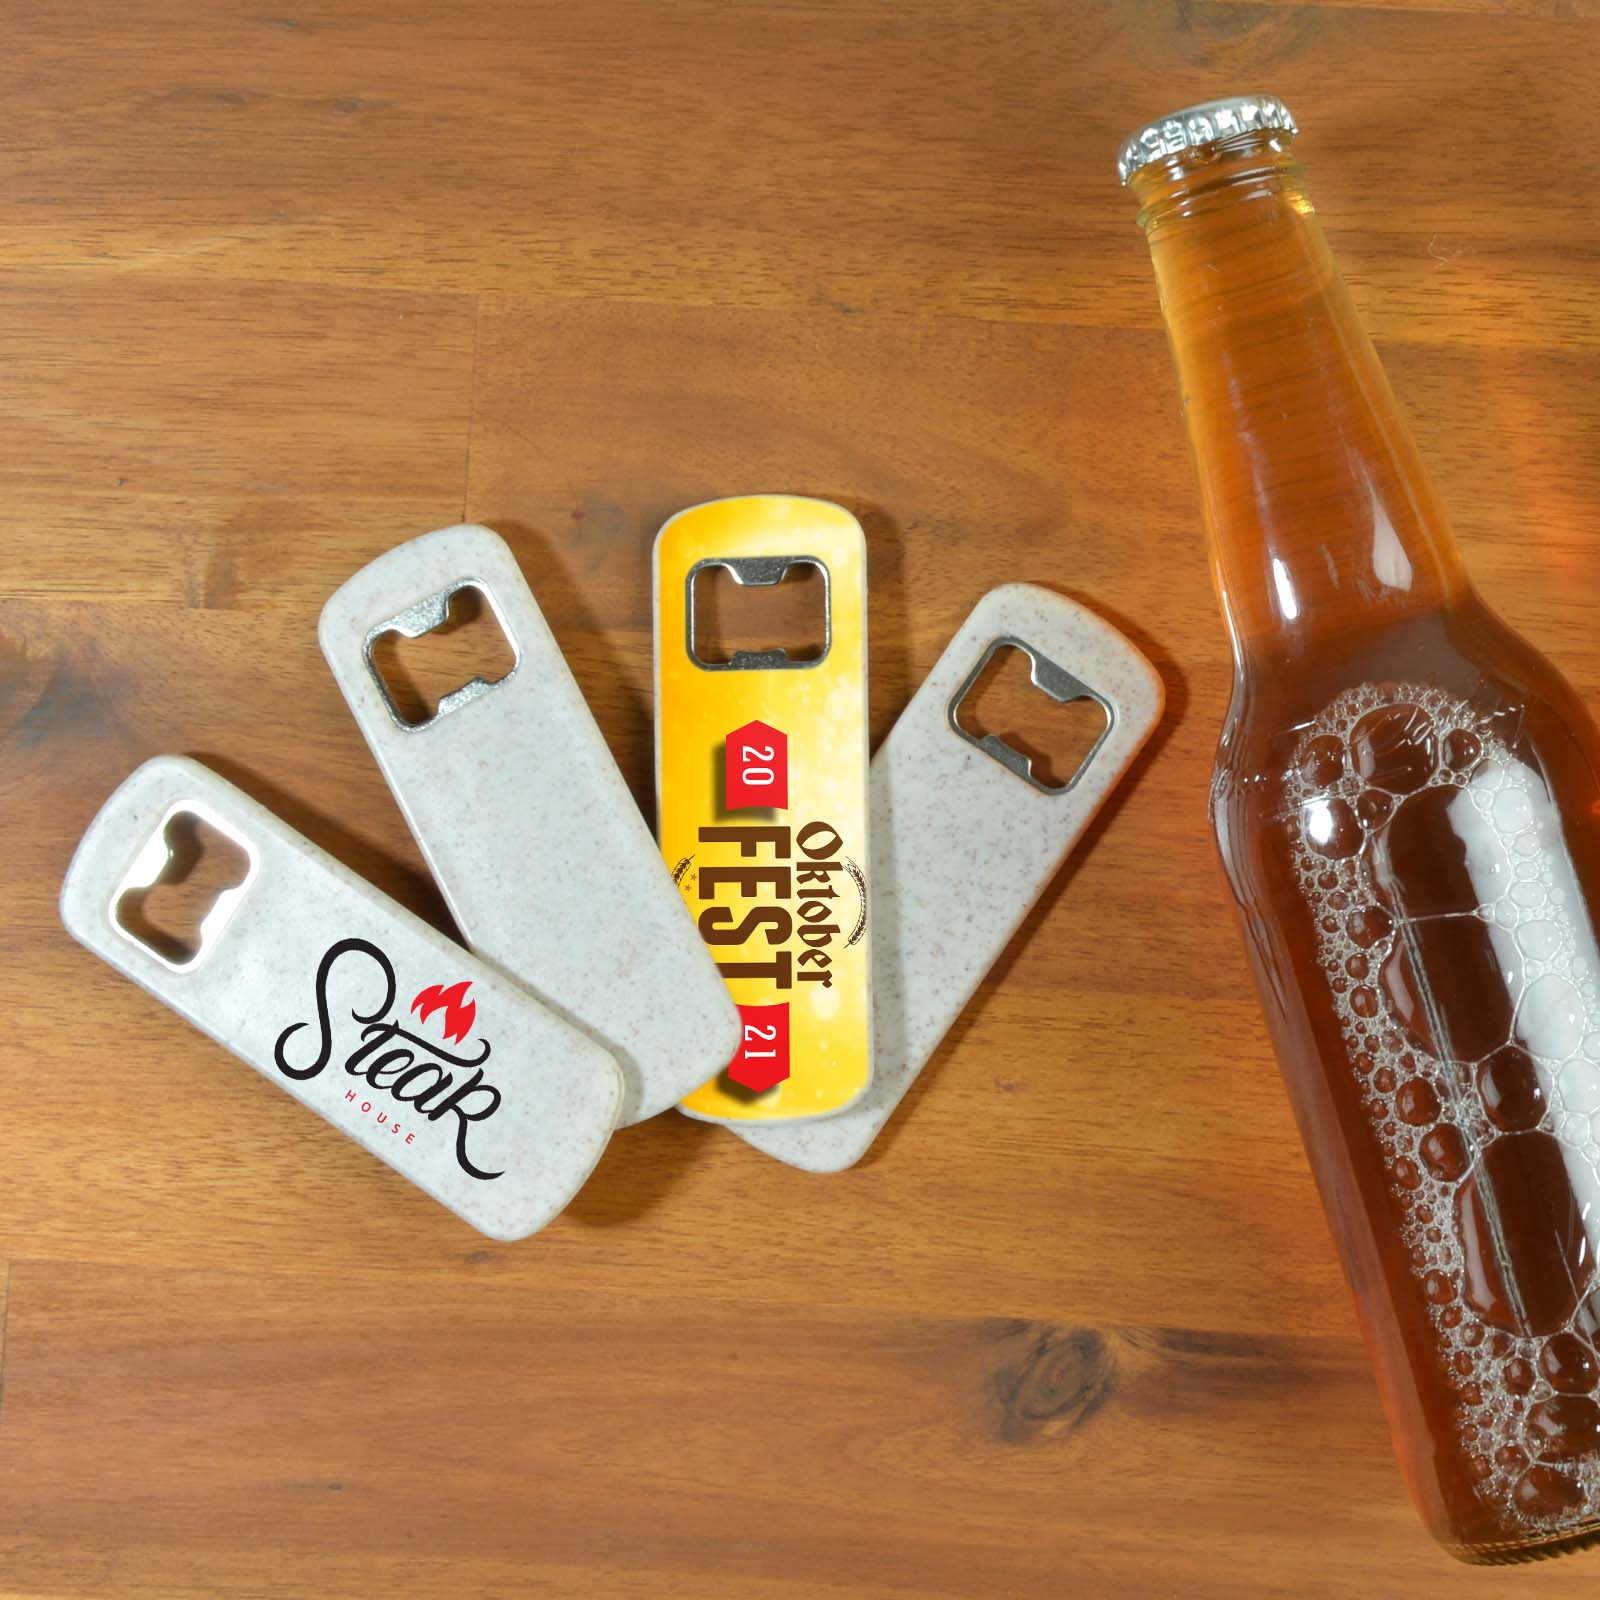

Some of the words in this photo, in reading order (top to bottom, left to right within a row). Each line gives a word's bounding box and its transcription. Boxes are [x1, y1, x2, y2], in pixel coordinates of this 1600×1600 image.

[742, 745, 775, 786] 20
[698, 826, 793, 990] FEST
[795, 821, 844, 989] Oktober
[744, 1024, 777, 1060] 21
[344, 1089, 417, 1145] HOUSE
